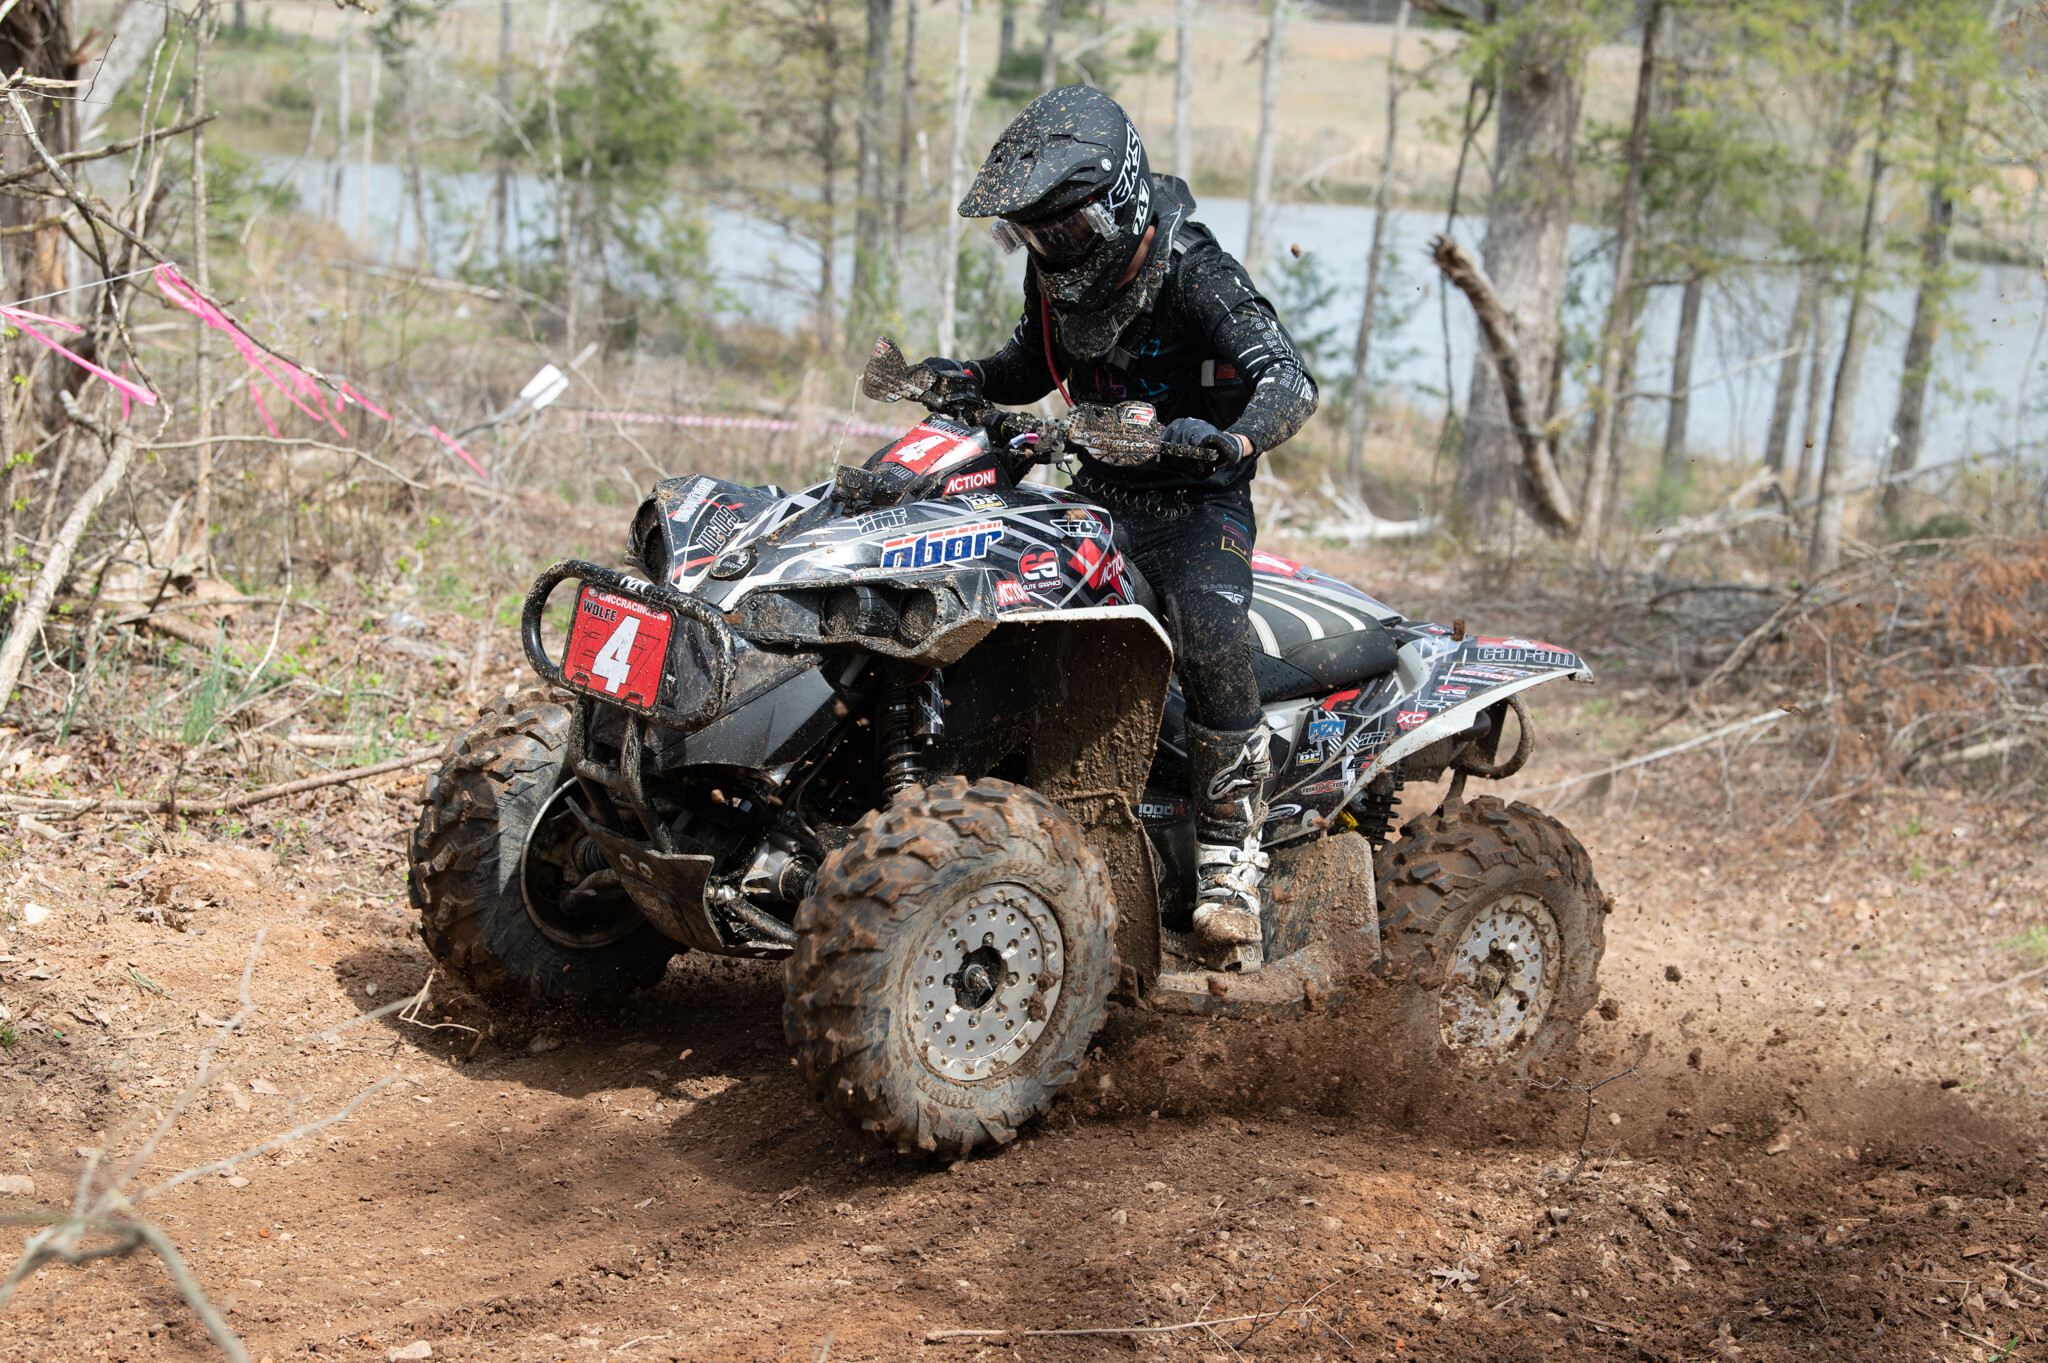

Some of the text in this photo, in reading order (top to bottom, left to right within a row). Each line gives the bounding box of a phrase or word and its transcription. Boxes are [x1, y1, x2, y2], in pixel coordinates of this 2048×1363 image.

[1132, 178, 1150, 235] 247
[895, 434, 948, 463] 4
[946, 470, 992, 494] ACTION
[854, 507, 908, 535] HMF
[998, 582, 1031, 604] ACTION
[1023, 579, 1062, 591] ELITE GRAPHICS
[583, 600, 618, 622] WOLFE
[598, 592, 668, 622] GNCCRACING.COM
[591, 614, 641, 695] 4
[1477, 646, 1576, 668] can-am
[1456, 668, 1515, 681] ACTION
[1309, 720, 1346, 737] MZM
[1397, 713, 1427, 724] XC
[1300, 752, 1320, 760] DP
[1138, 803, 1187, 817] 1000R
